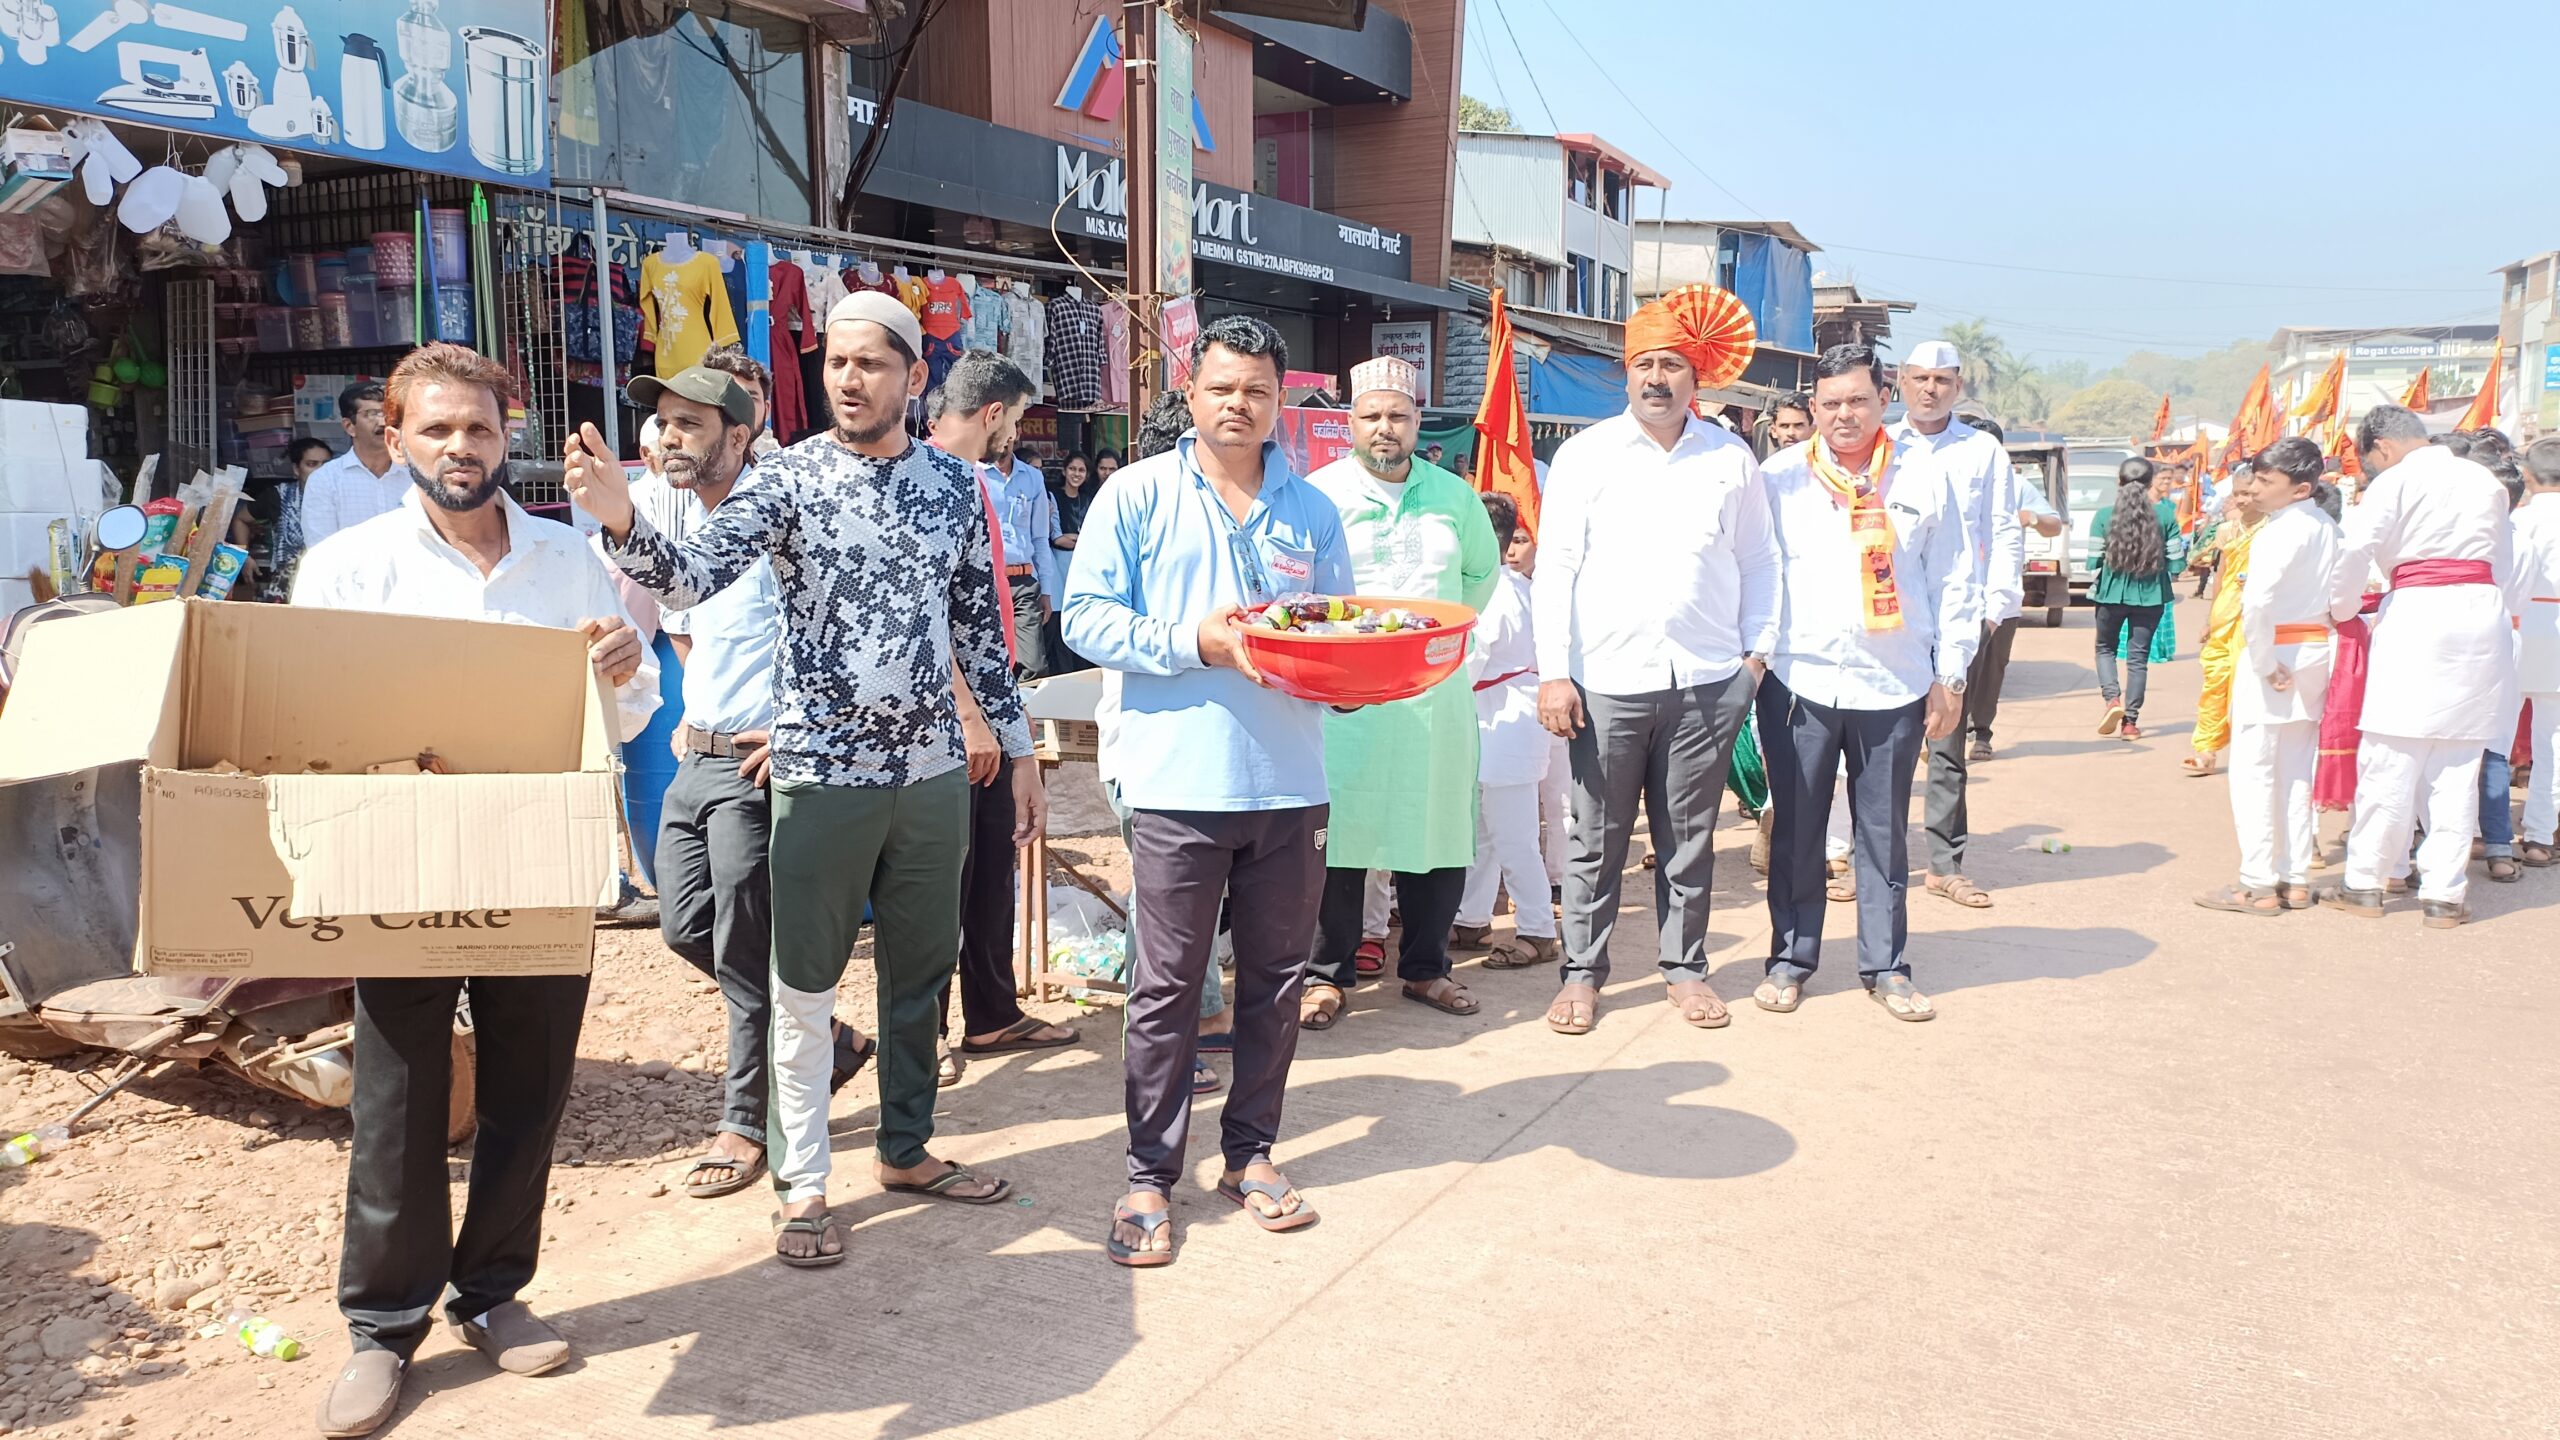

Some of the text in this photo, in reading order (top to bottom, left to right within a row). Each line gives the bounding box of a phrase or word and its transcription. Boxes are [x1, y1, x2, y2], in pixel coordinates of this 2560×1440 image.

[1200, 240, 1234, 262] MEMON
[1338, 224, 1401, 256] मालाणी मार्ट
[1401, 342, 1425, 355] मिरची
[2355, 345, 2435, 357] Regal College
[231, 895, 345, 942] Veg
